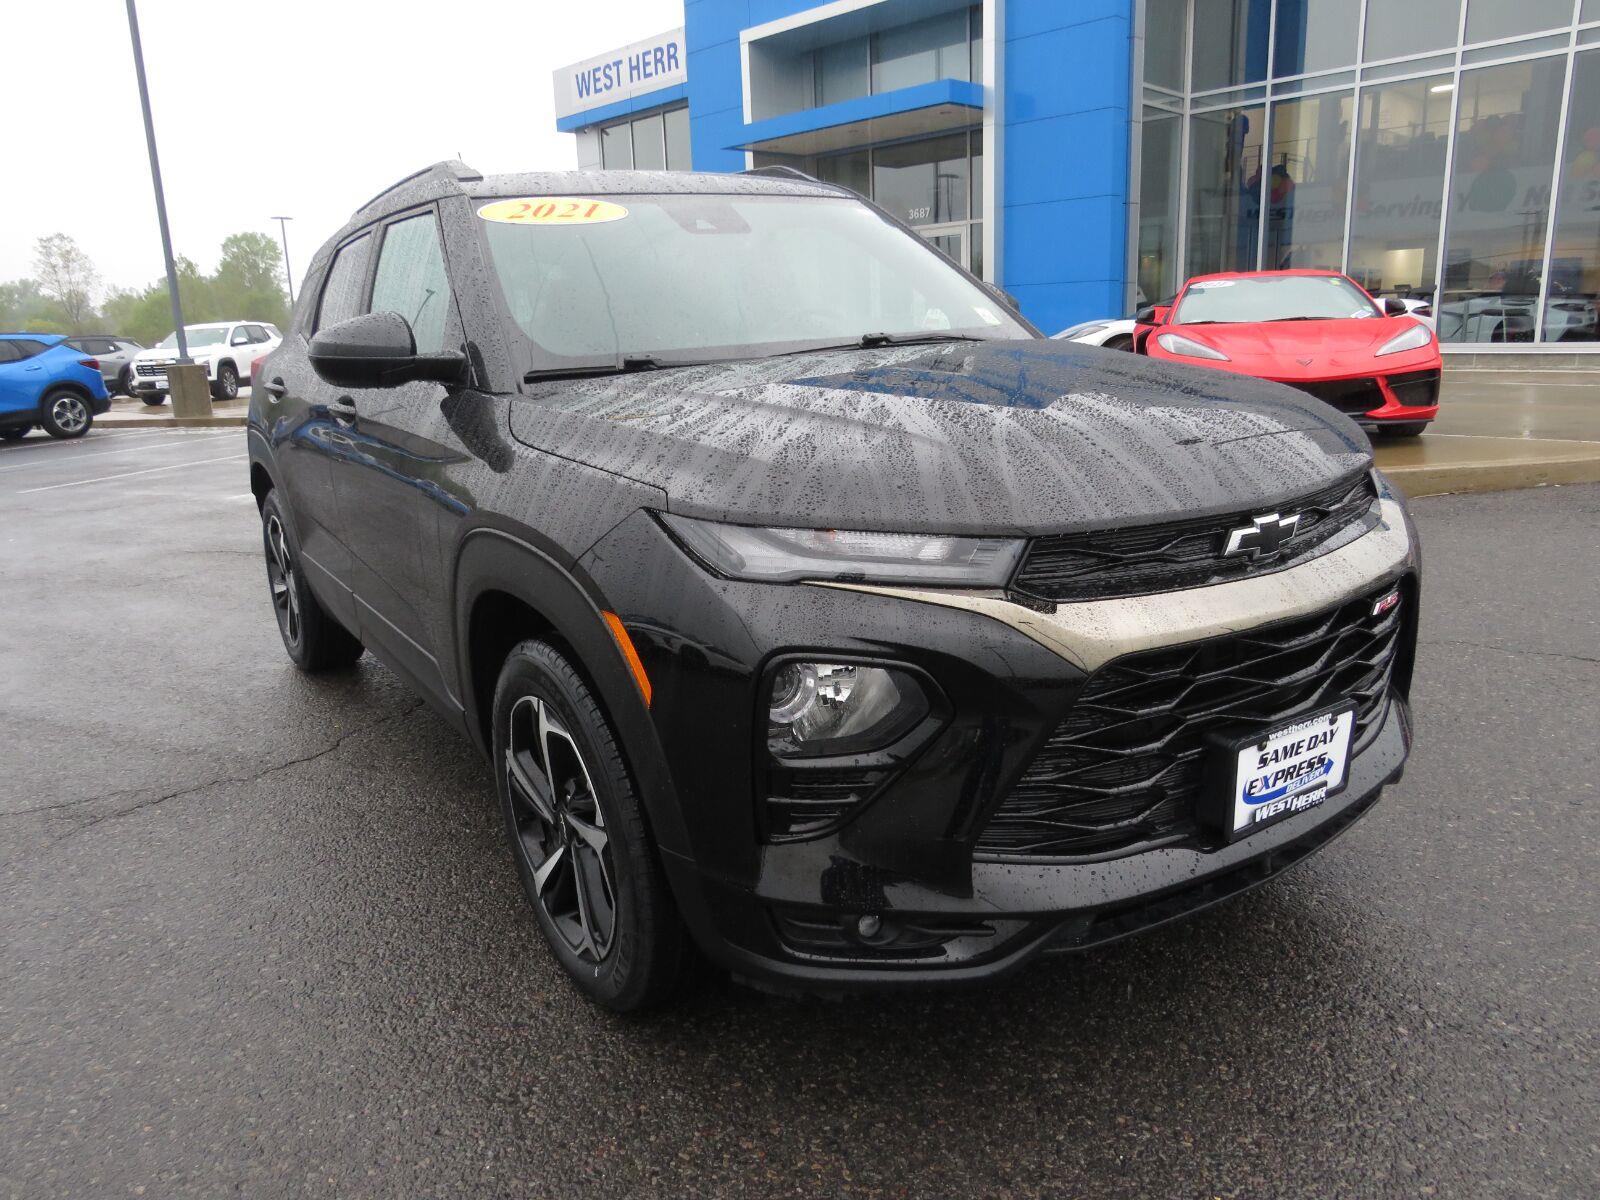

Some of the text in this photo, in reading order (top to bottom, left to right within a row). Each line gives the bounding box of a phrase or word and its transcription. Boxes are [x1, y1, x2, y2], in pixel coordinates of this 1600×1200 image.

[575, 42, 679, 98] WEST HERR
[507, 203, 600, 219] 2021
[909, 206, 931, 219] 3687
[1268, 713, 1332, 740] westherr.com
[1257, 726, 1339, 770] SAME DAY
[1248, 752, 1328, 796] EXPRESS
